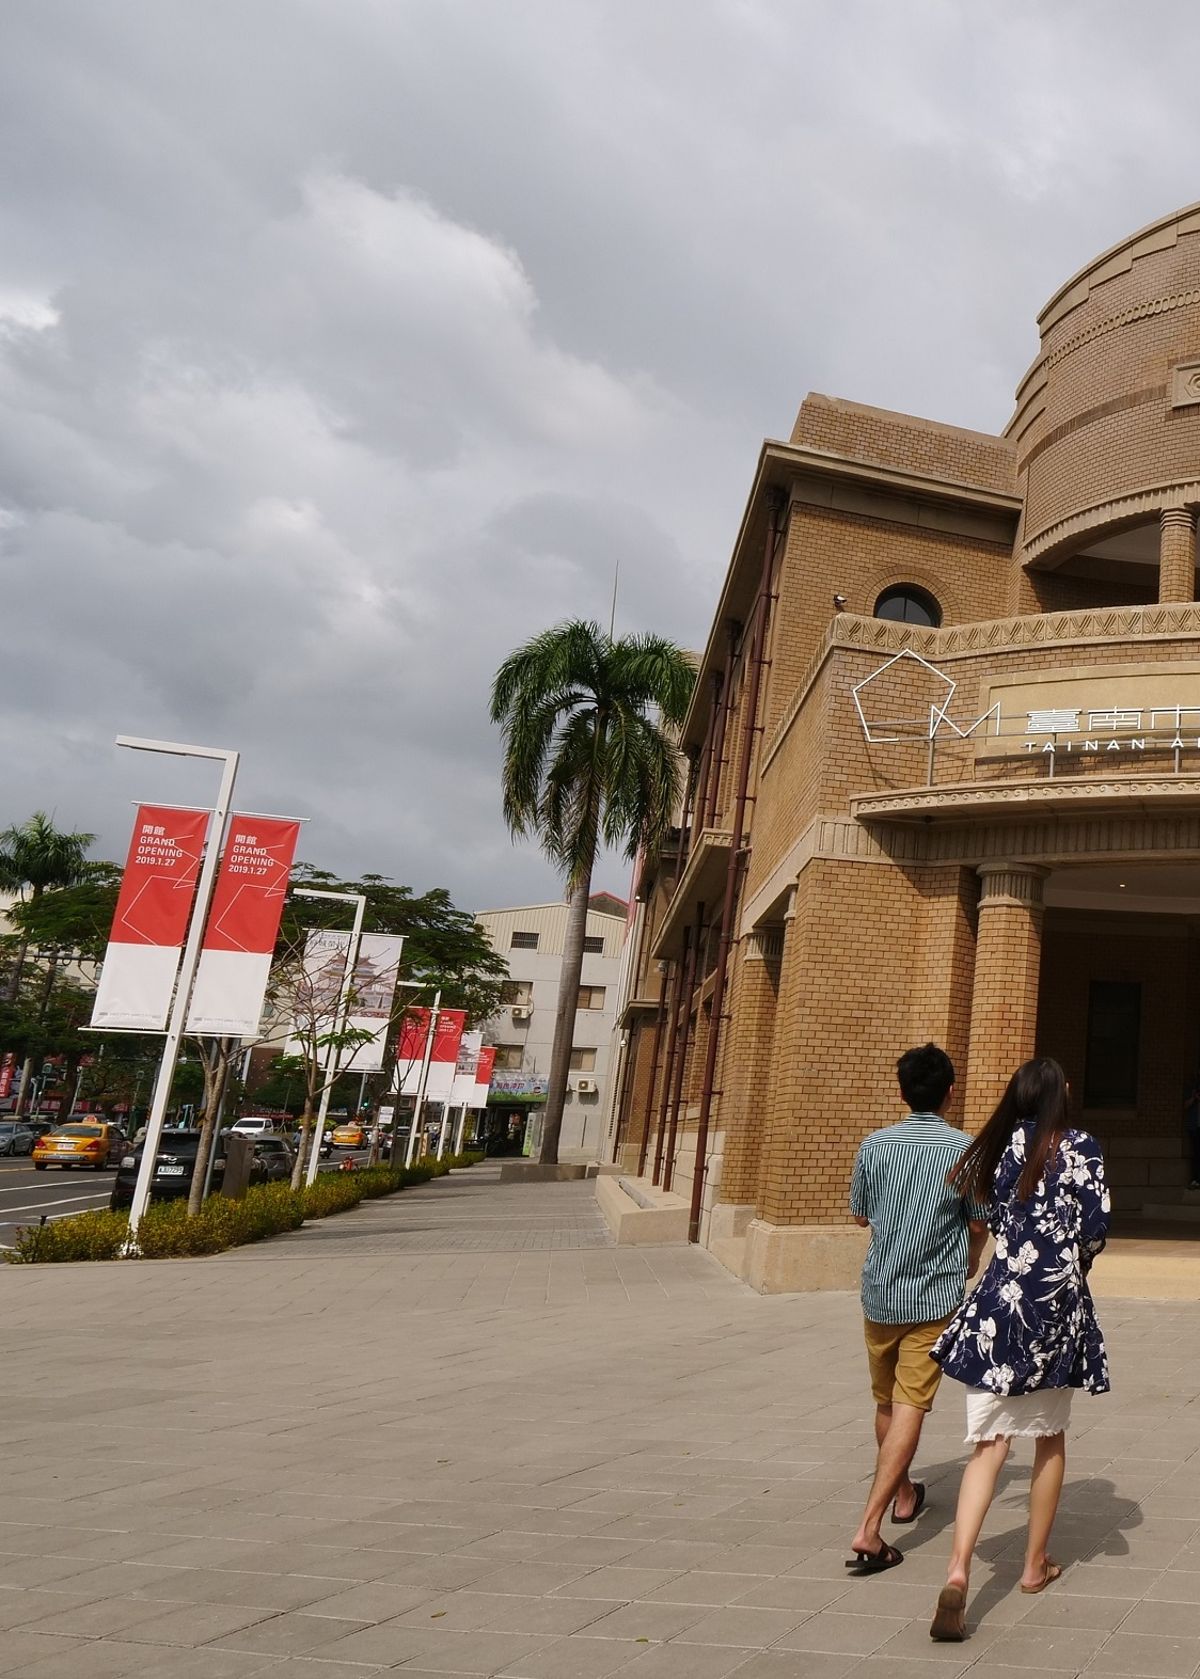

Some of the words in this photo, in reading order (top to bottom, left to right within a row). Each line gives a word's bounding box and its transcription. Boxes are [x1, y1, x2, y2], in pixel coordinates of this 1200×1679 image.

[1025, 738, 1145, 752] TAINAN
[142, 824, 165, 836] 開館
[140, 836, 176, 847] GRAND
[235, 834, 257, 846] 開館
[138, 845, 183, 858] OPENING
[233, 845, 267, 856] GRAND
[135, 855, 176, 867] 2019.1.27
[231, 855, 274, 868] OPENING
[228, 865, 268, 876] 2019.1.27
